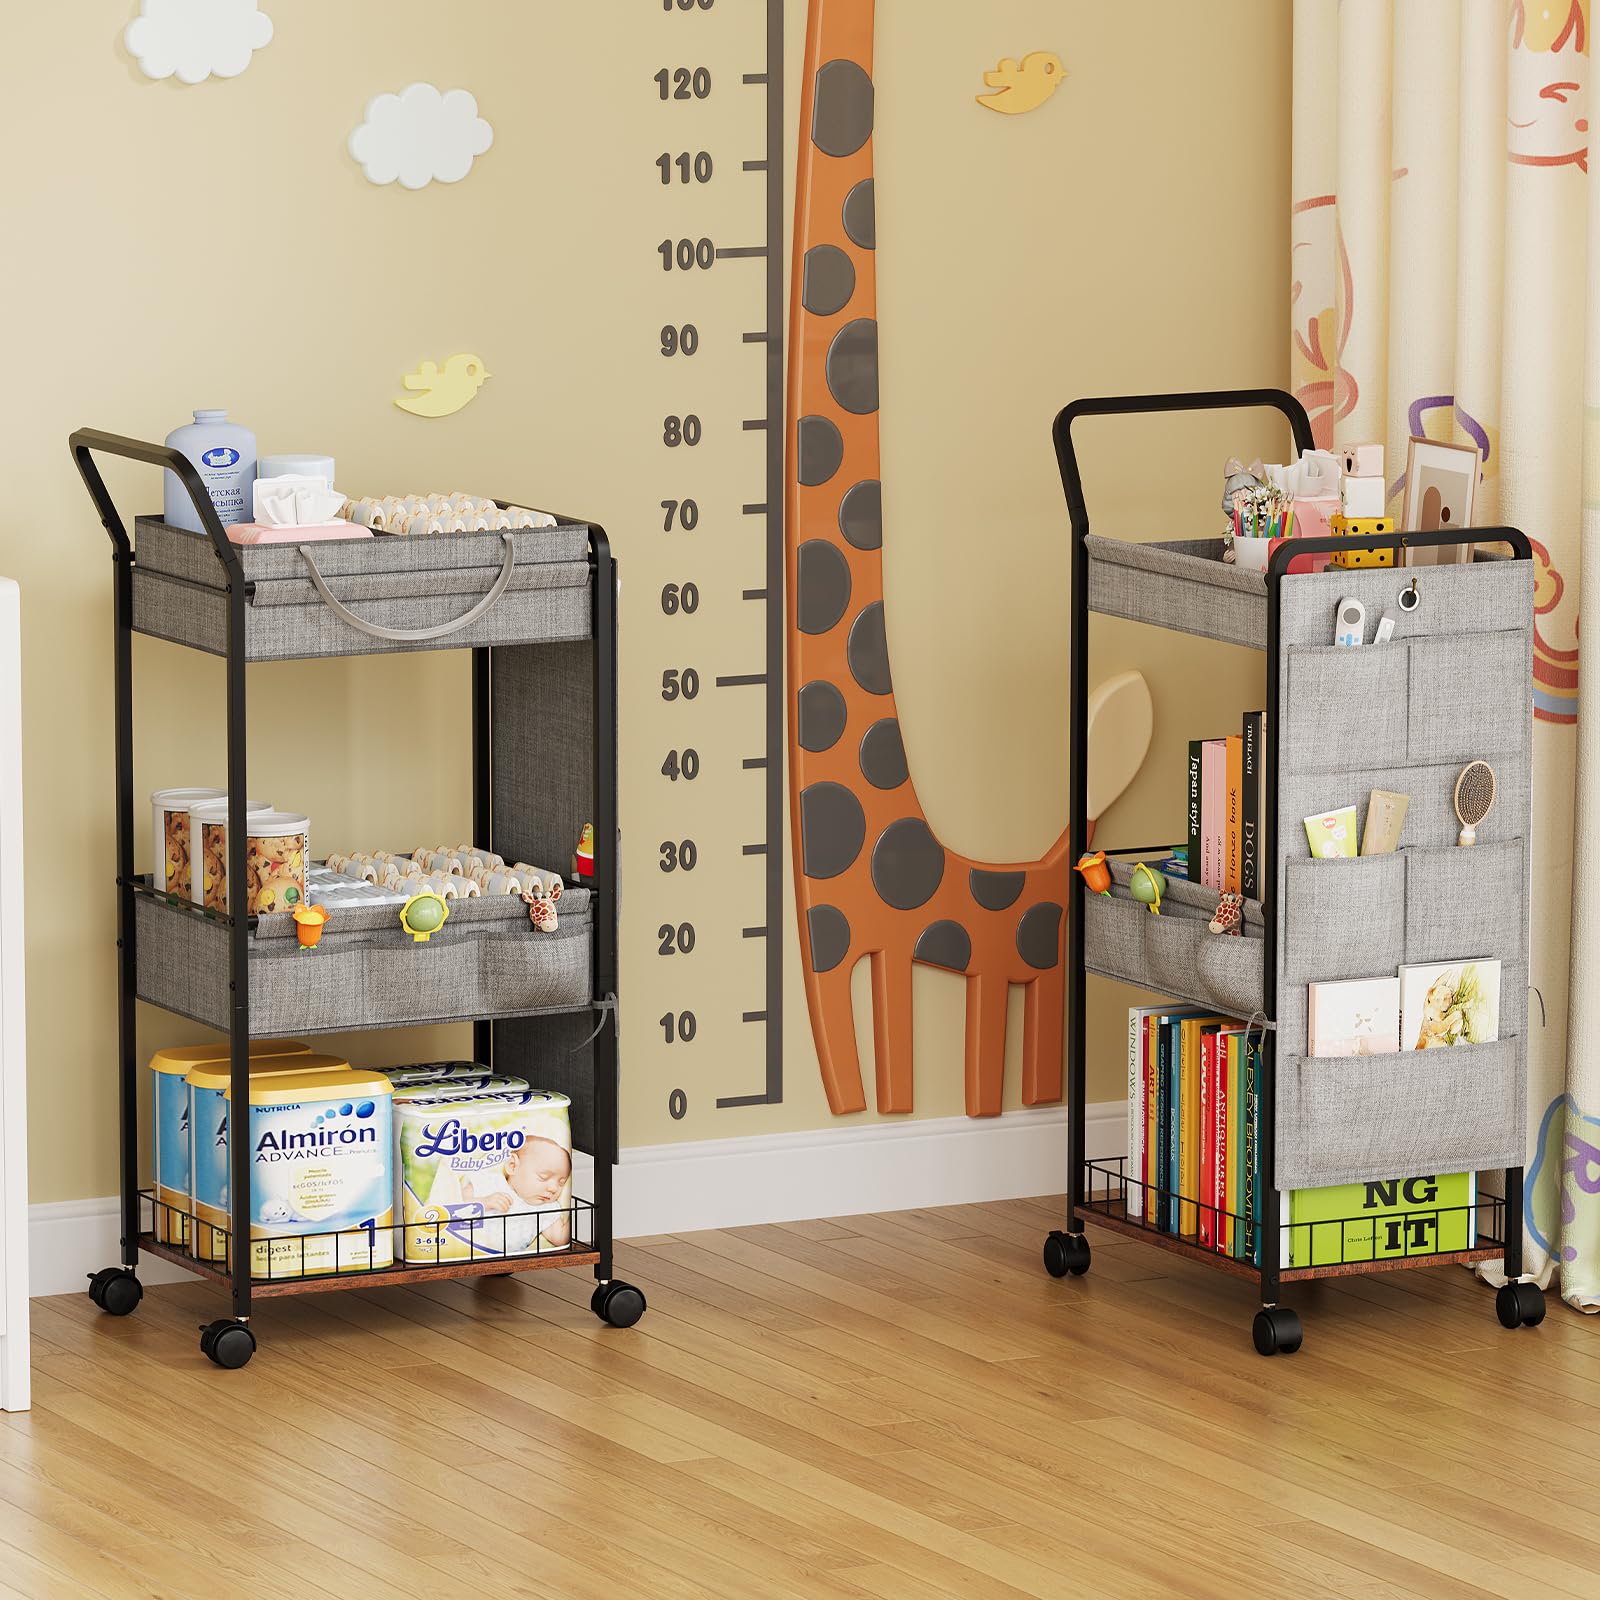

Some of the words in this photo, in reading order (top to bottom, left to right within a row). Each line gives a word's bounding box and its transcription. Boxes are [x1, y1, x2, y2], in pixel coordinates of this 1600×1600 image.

[654, 67, 711, 100] 120
[656, 151, 713, 184] 110
[658, 238, 715, 271] 100
[660, 324, 699, 357] 90
[663, 415, 701, 448] 80
[661, 499, 699, 532] 70
[661, 582, 699, 615] 60
[661, 668, 699, 701] 50
[661, 749, 699, 781] 40
[1190, 755, 1200, 798] Japan
[1191, 802, 1200, 836] style
[1229, 787, 1237, 824] book
[660, 840, 698, 873] 30
[1244, 820, 1255, 889] DOGS
[658, 922, 696, 955] 20
[660, 1010, 697, 1044] 10
[1246, 1042, 1254, 1118] ALEXEY
[255, 1104, 301, 1113] NUTRICIA
[669, 1088, 688, 1120] 0
[256, 1123, 376, 1152] Almirón
[415, 1118, 525, 1158] Libero
[255, 1146, 343, 1163] ADVANCE
[450, 1156, 484, 1170] Baby
[485, 1149, 511, 1166] Soft
[1245, 1122, 1254, 1246] BRODOVITCH
[1362, 1175, 1438, 1209] NG
[359, 1218, 377, 1247] 1
[424, 1209, 440, 1228] 2
[1384, 1218, 1436, 1251] IT
[256, 1244, 292, 1256] digest
[415, 1237, 432, 1245] 3-6
